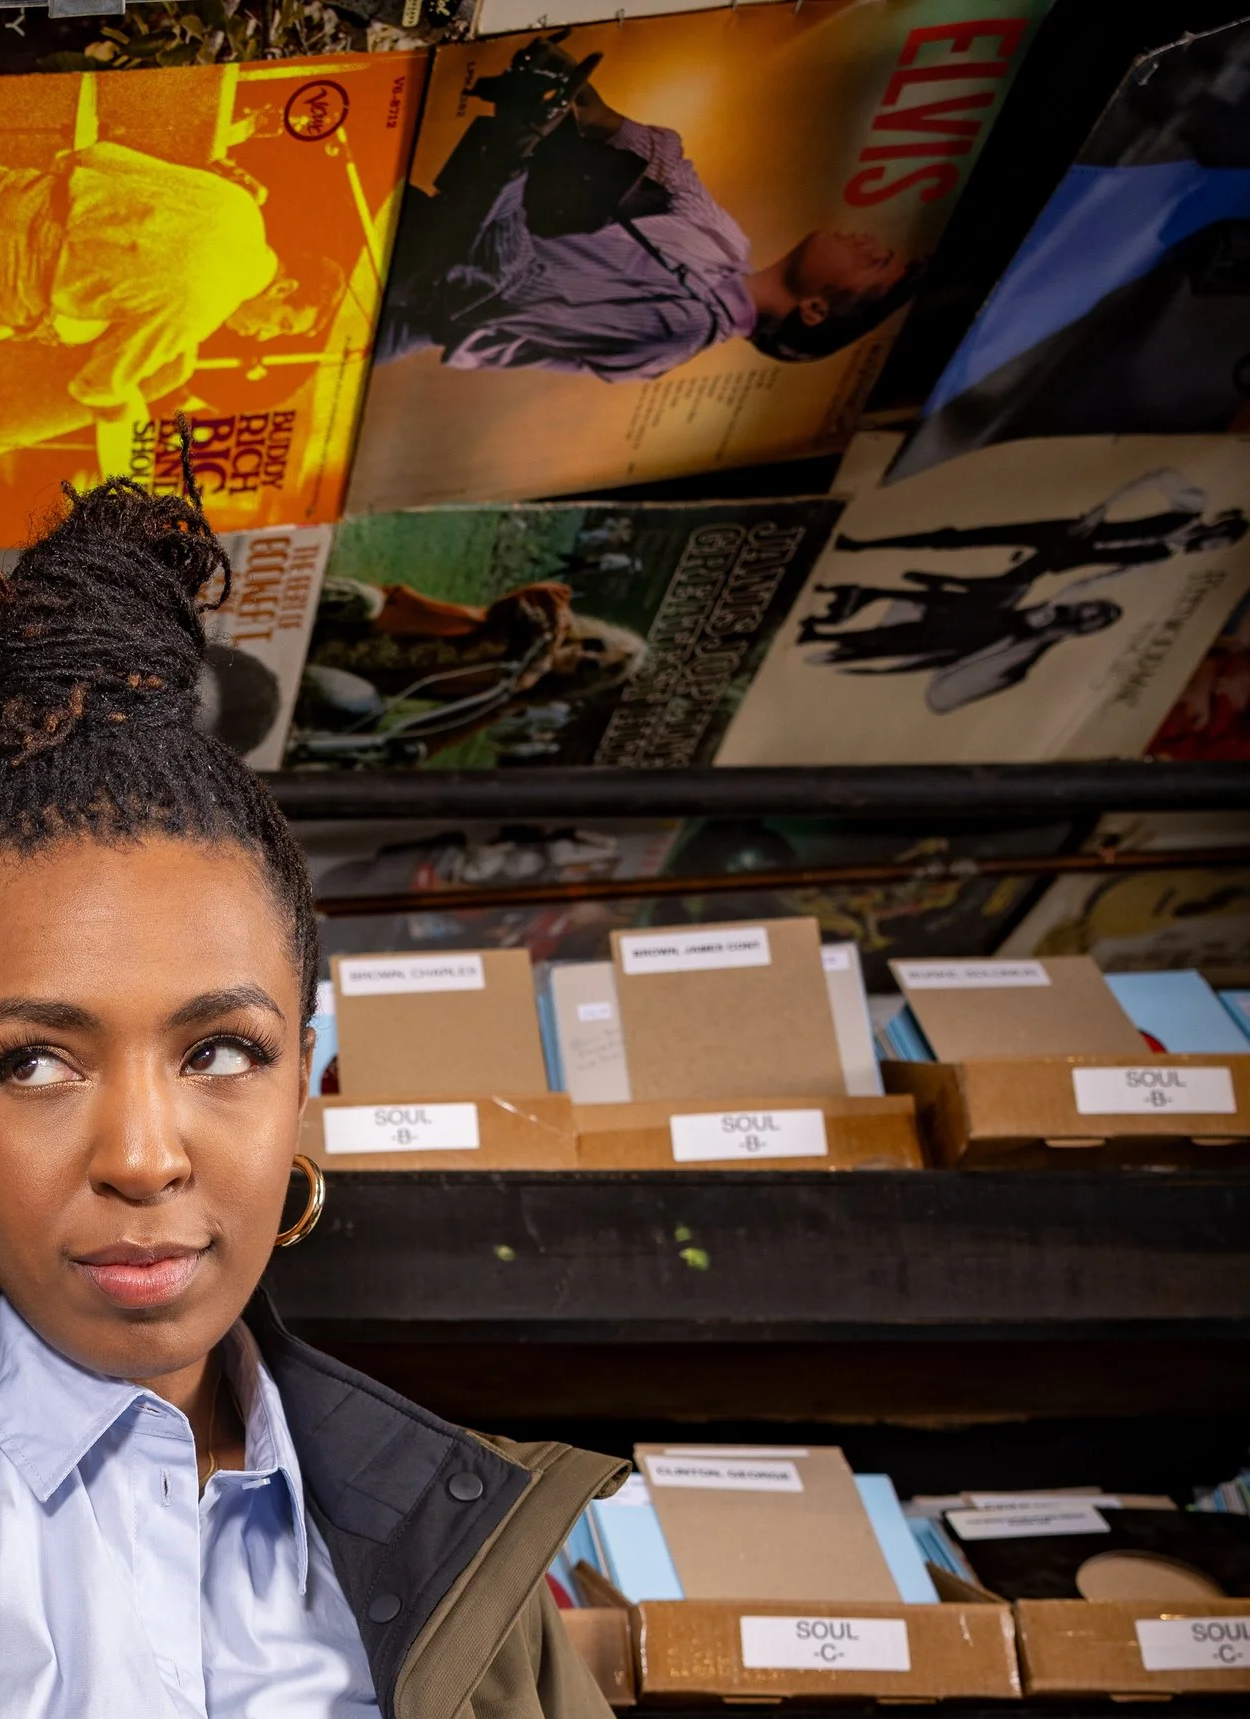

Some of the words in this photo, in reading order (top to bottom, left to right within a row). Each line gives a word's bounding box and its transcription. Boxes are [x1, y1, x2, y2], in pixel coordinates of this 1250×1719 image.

[841, 18, 1031, 208] ELVIS
[187, 415, 235, 496] BIG
[228, 411, 269, 497] RICH
[261, 409, 296, 491] BUDDY
[704, 521, 808, 637] JANIS
[410, 966, 479, 978] CHARLES
[1125, 1069, 1187, 1089] SOUL
[374, 1108, 433, 1126] SOUL
[720, 1114, 781, 1134] SOUL
[795, 1620, 860, 1641] SOUL
[812, 1642, 846, 1664] -C-
[1212, 1643, 1244, 1666] -C-
